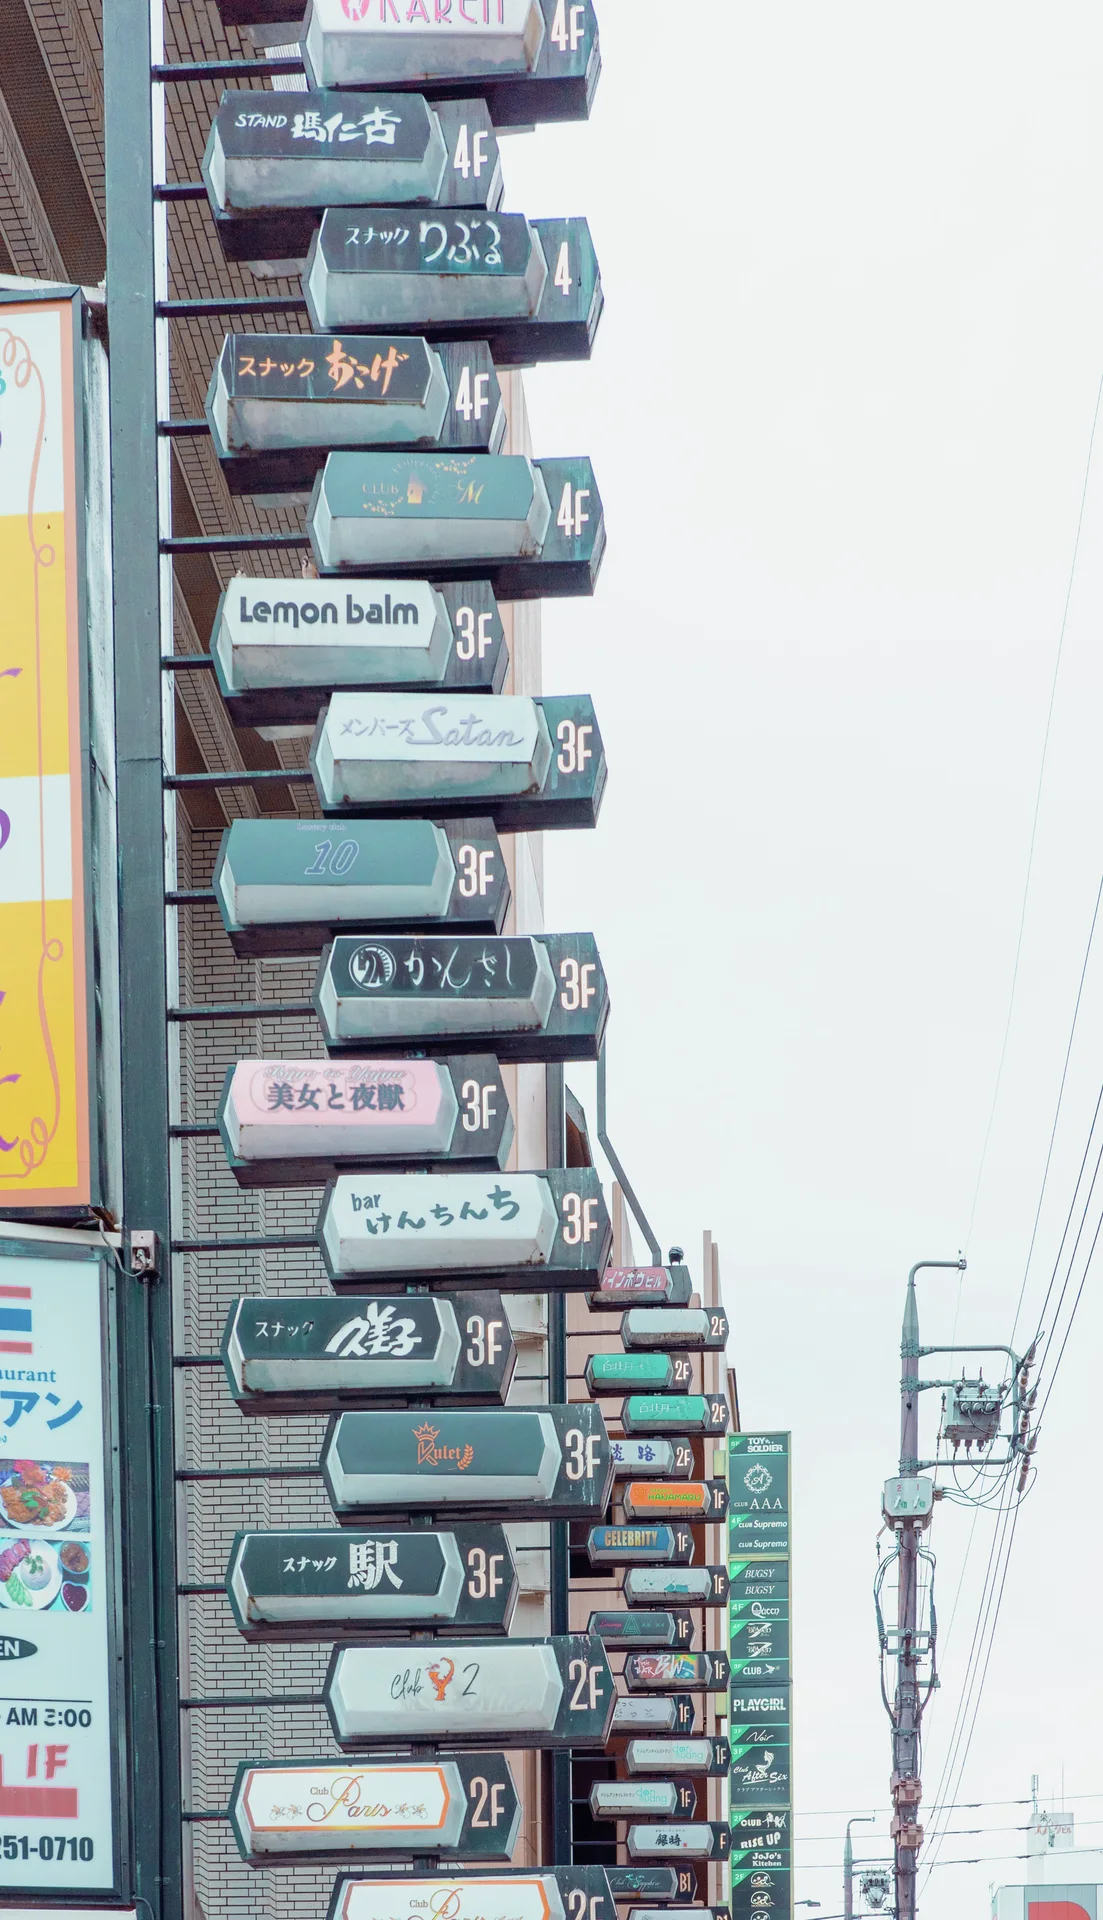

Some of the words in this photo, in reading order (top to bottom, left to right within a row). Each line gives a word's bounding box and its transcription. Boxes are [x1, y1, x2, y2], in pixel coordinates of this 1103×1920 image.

[550, 5, 585, 51] 4F
[235, 113, 288, 129] STAND
[453, 124, 489, 178] 4F
[345, 225, 410, 246] スナック
[419, 219, 502, 264] りぶる
[553, 241, 571, 296] 4
[238, 357, 315, 377] スナック
[455, 366, 489, 421] 4F
[362, 483, 399, 494] CLUB
[557, 482, 590, 536] 4F
[240, 596, 338, 628] Lemon
[346, 594, 419, 625] balm
[456, 606, 493, 661] 3F
[341, 717, 415, 736] メンバーズ
[405, 706, 525, 747] Satan
[556, 720, 593, 774] 3F
[304, 839, 360, 876] 10
[458, 845, 495, 898] 3F
[403, 944, 515, 989] かんざし
[561, 958, 596, 1011] 3F
[462, 1079, 497, 1132] 3F
[351, 1193, 381, 1211] bar
[366, 1185, 520, 1235] けんちんち
[562, 1193, 598, 1245] 3F
[255, 1321, 315, 1337] スナック
[324, 1301, 422, 1357] 久美子
[711, 1316, 725, 1336] 2F
[466, 1315, 502, 1366] 3F
[675, 1360, 689, 1380] 2F
[712, 1403, 726, 1423] 2F
[747, 1437, 766, 1445] TOY
[747, 1444, 783, 1452] SOLDIER
[565, 1429, 600, 1480] 3F
[676, 1447, 690, 1467] 2F
[648, 1493, 701, 1501] HANAMARU
[713, 1489, 724, 1508] 1F
[754, 1520, 787, 1530] Supremo
[604, 1530, 658, 1547] CELEBRITY
[677, 1532, 688, 1552] 1F
[754, 1540, 787, 1550] Supremo
[283, 1556, 338, 1573] スナック
[347, 1540, 404, 1591] 駅
[468, 1548, 503, 1599] 3F
[745, 1569, 775, 1578] BUGSY
[713, 1574, 725, 1594] 1F
[745, 1585, 775, 1595] BUGSY
[732, 1603, 744, 1611] 4F
[677, 1618, 689, 1638] 1F
[714, 1660, 725, 1679] 1F
[743, 1666, 762, 1675] CLUB
[391, 1668, 424, 1700] Club
[462, 1663, 480, 1696] 2
[569, 1659, 603, 1711] 2F
[679, 1703, 689, 1723] 1F
[733, 1698, 786, 1712] PLAYGIRL
[6, 1707, 37, 1726] AM
[716, 1745, 726, 1764] 1F
[742, 1770, 769, 1782] After
[769, 1772, 788, 1783] Six
[306, 1775, 392, 1823] Paris
[310, 1786, 329, 1796] Club
[680, 1788, 691, 1807] 1F
[470, 1776, 506, 1829] 2F
[740, 1819, 762, 1827] CLUB
[720, 1833, 726, 1849] F
[740, 1836, 764, 1849] RISE
[766, 1832, 781, 1845] UP
[752, 1852, 781, 1860] JoJo's
[680, 1872, 691, 1892] B1
[409, 1900, 428, 1908] Club
[568, 1888, 604, 1920] 2F
